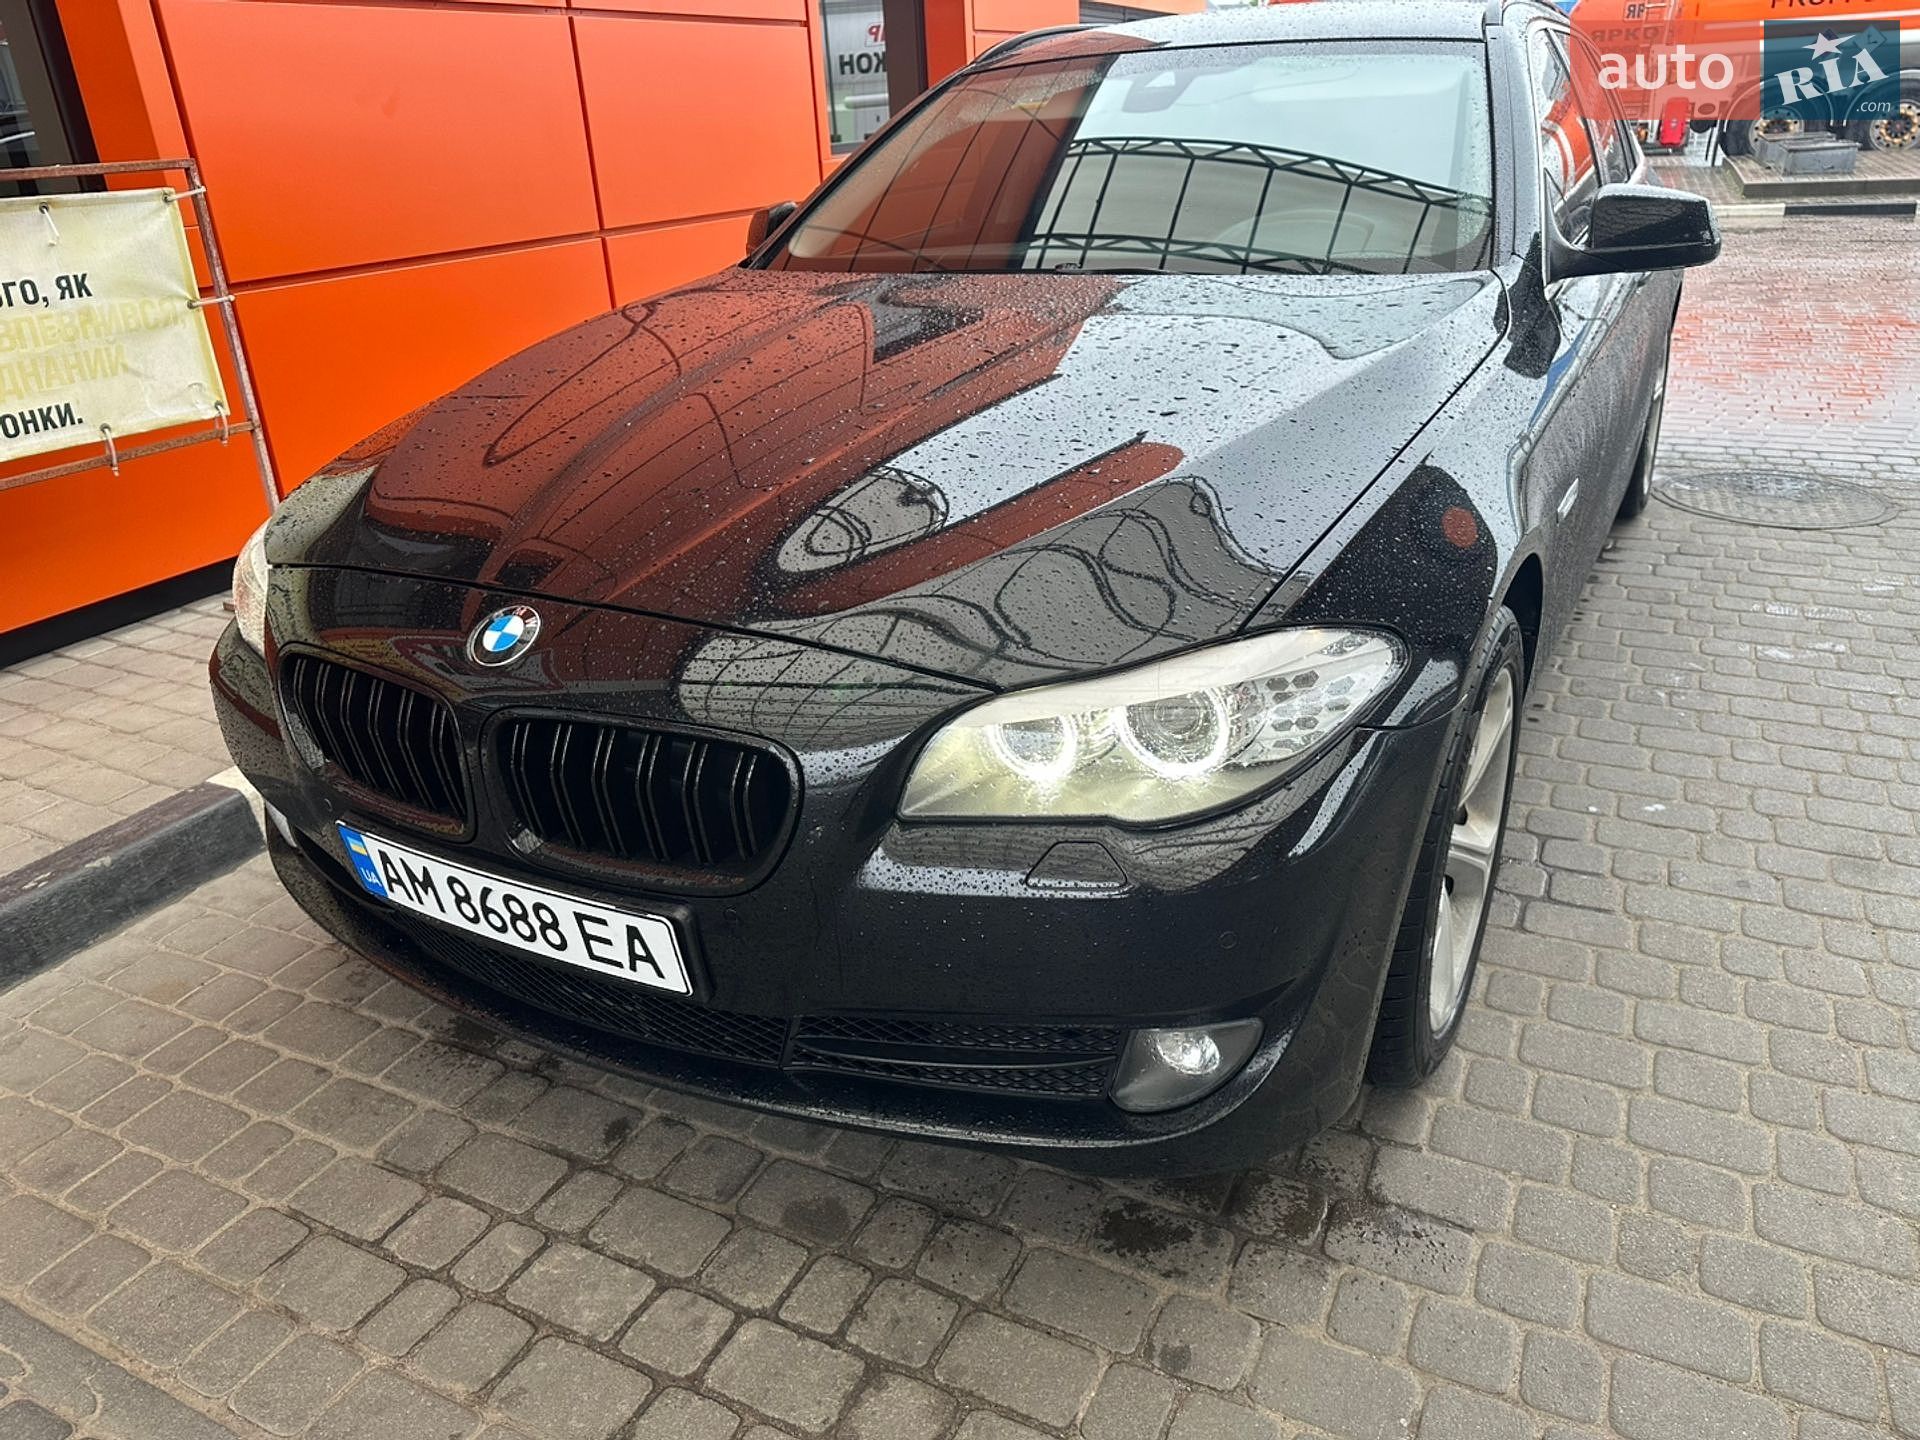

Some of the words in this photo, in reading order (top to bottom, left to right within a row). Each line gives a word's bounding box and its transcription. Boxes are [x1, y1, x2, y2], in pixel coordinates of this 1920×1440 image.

[0, 279, 49, 308] ГО,
[55, 273, 93, 300] ЯК
[360, 867, 383, 887] UA
[378, 849, 446, 914] AM
[447, 875, 568, 951] 8688
[572, 911, 666, 979] EA
